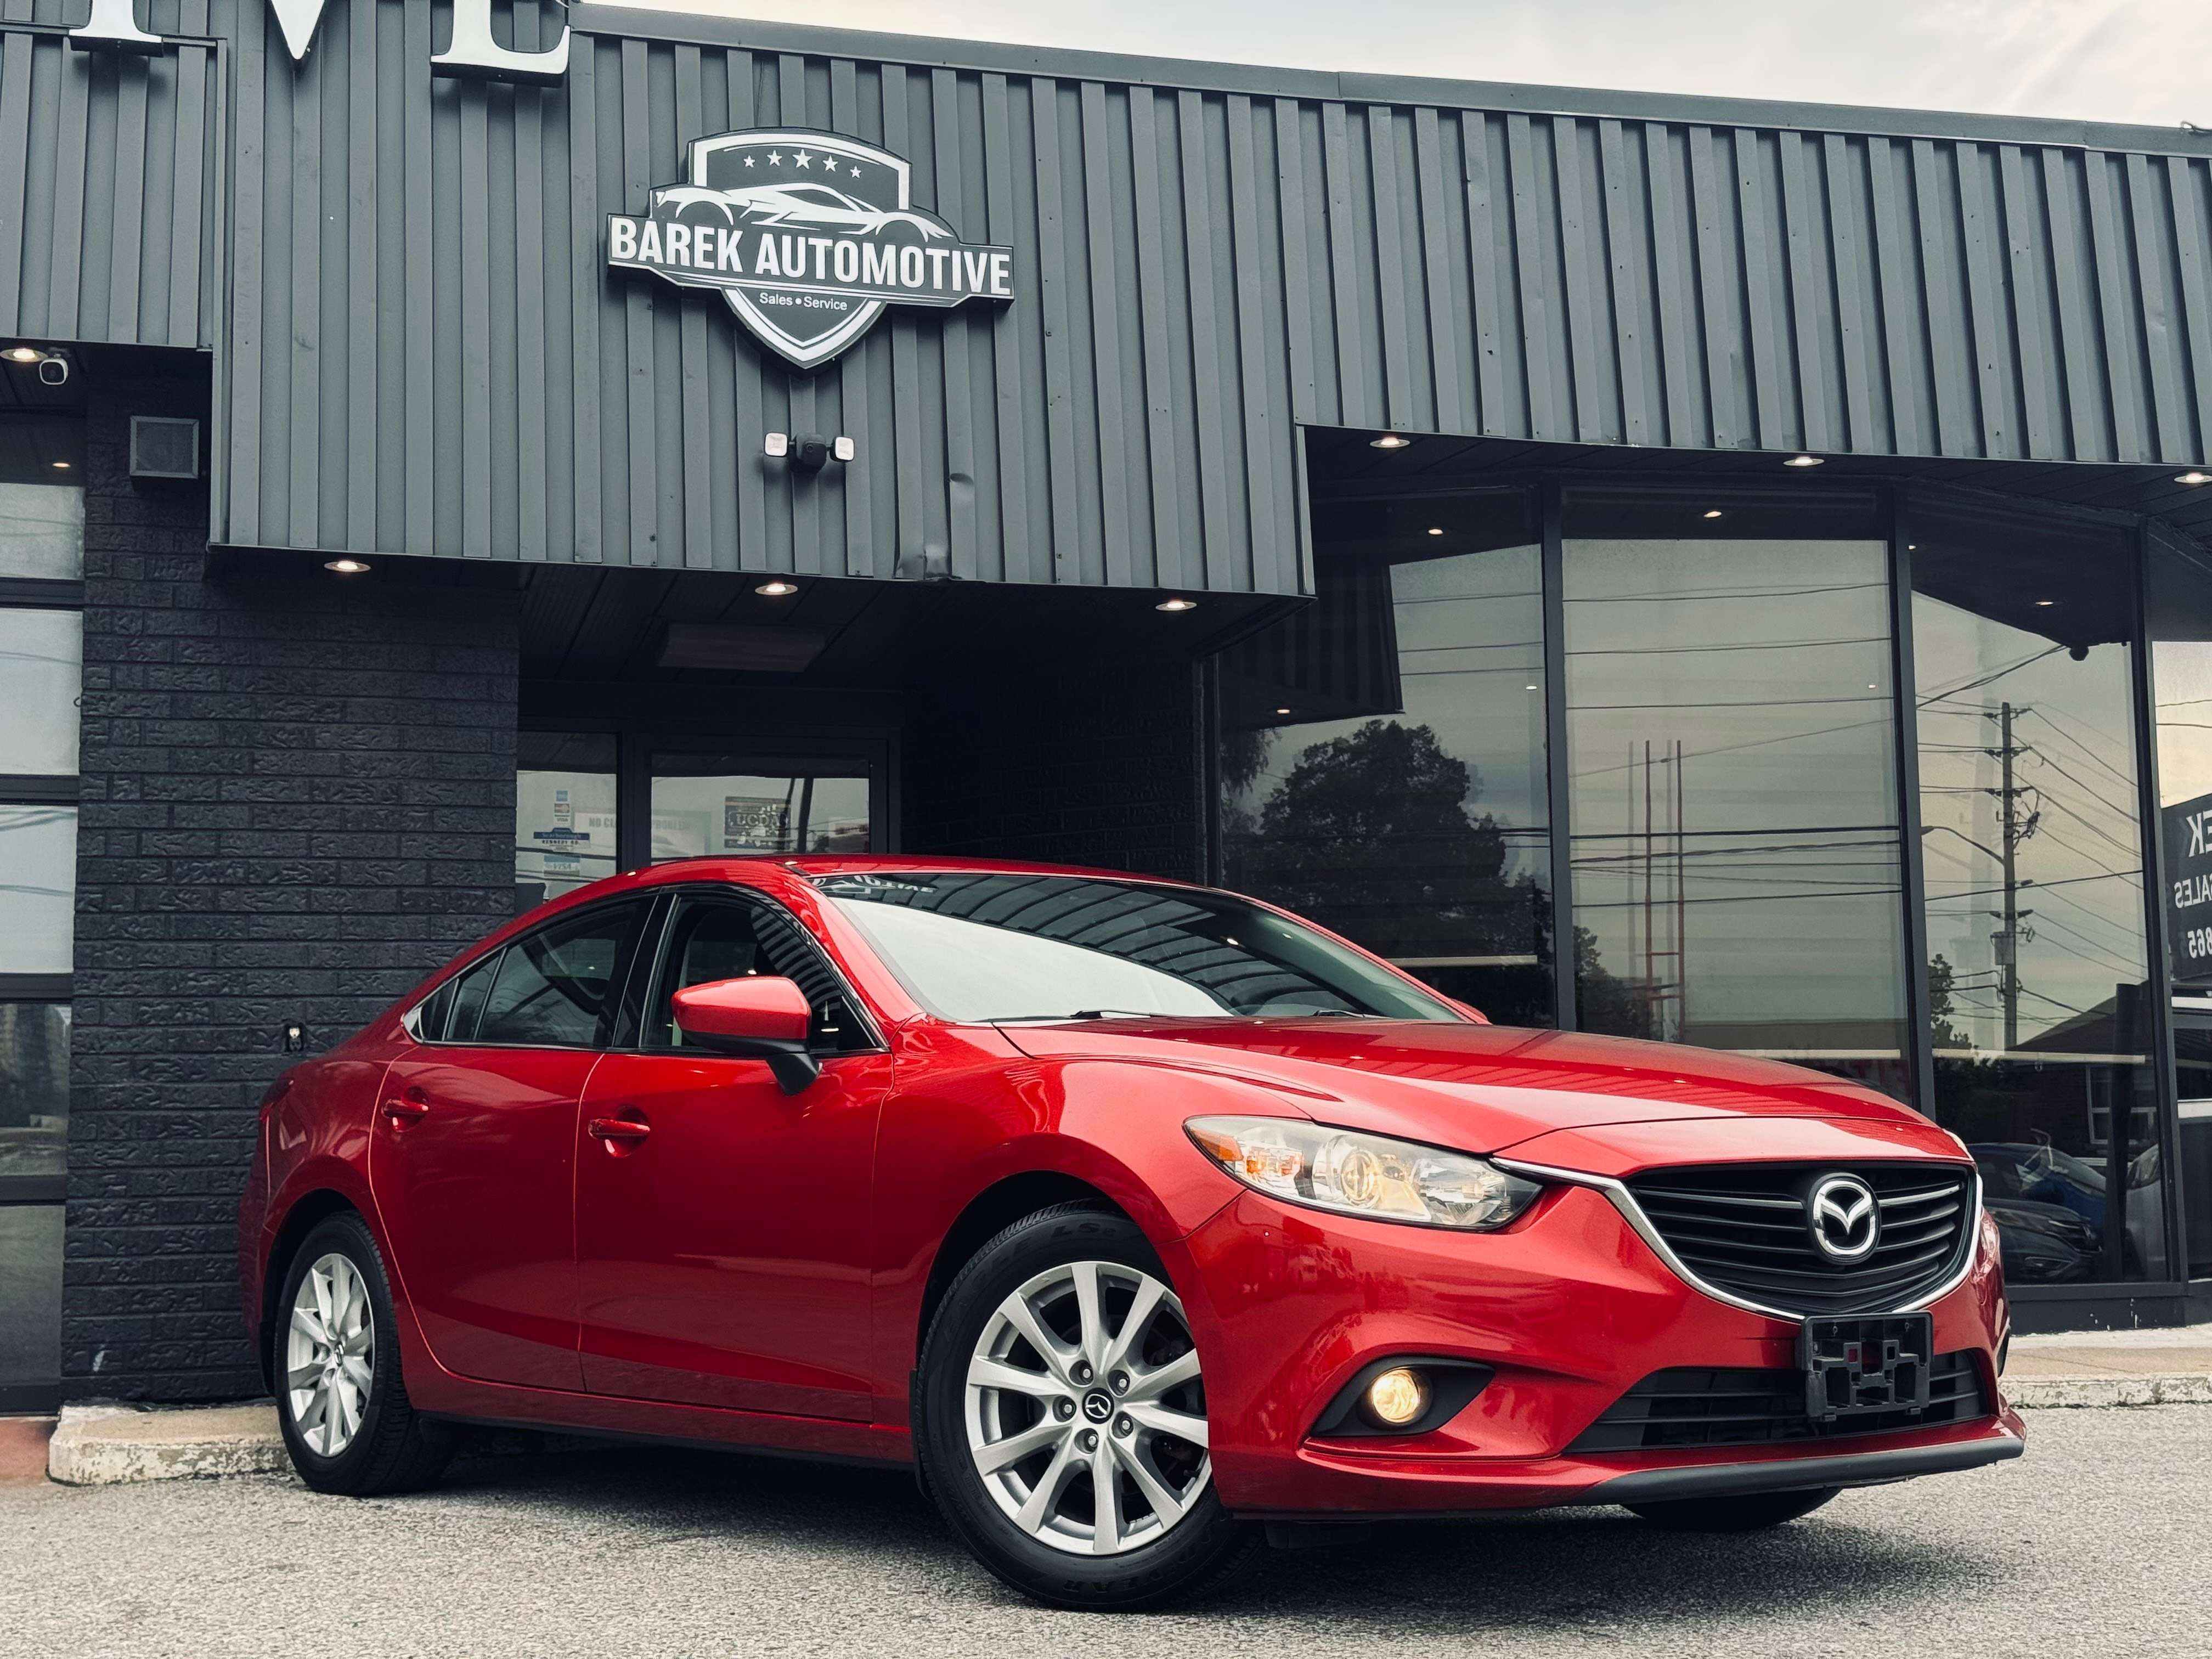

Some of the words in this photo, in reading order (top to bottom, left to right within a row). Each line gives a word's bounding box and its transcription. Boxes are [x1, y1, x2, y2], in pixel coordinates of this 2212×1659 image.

[611, 217, 744, 273] BAREK
[754, 233, 1011, 295] AUTOMOTIVE
[759, 292, 793, 306] Sales
[804, 296, 848, 311] Service
